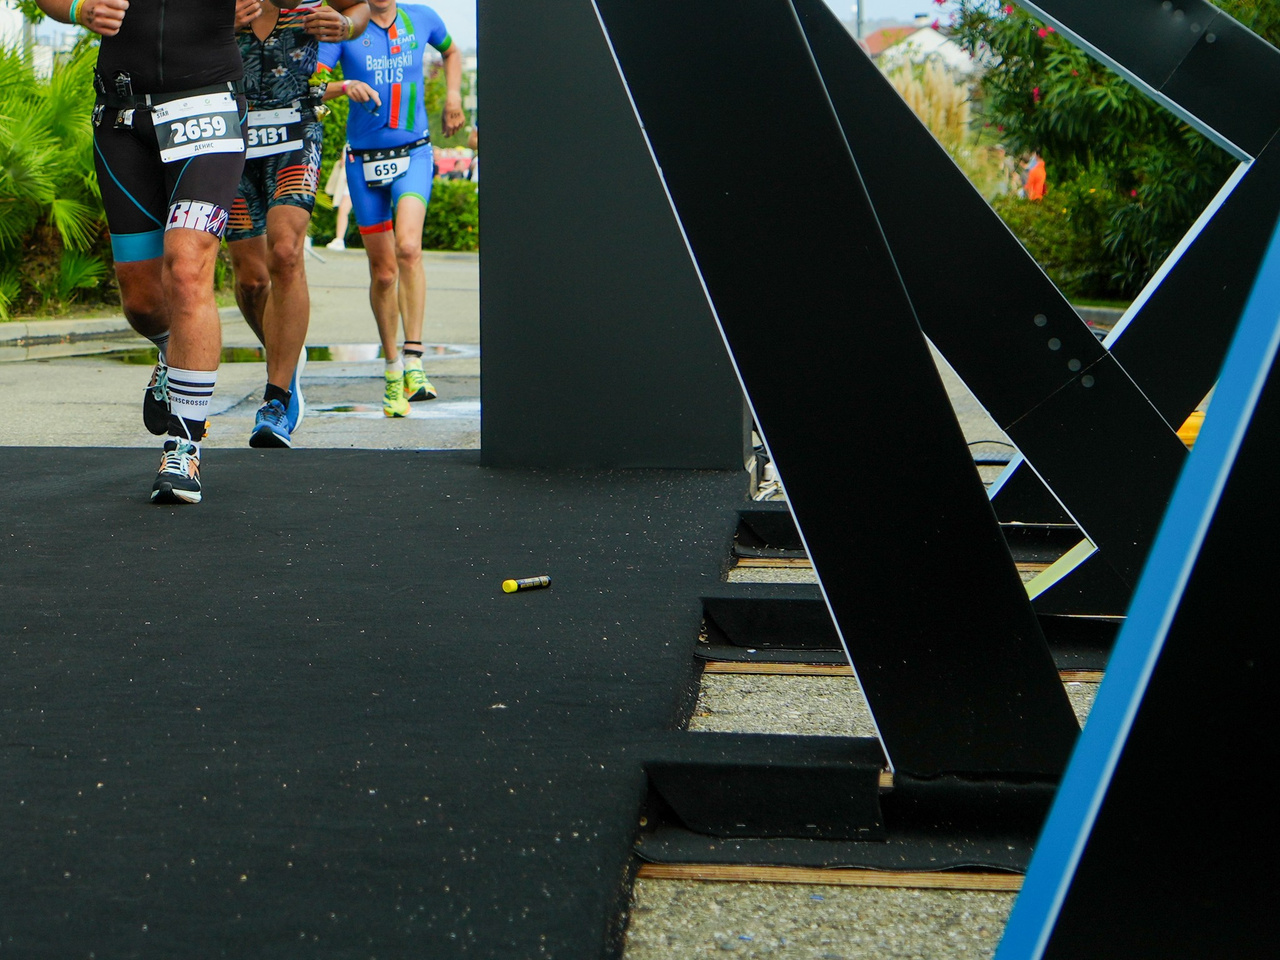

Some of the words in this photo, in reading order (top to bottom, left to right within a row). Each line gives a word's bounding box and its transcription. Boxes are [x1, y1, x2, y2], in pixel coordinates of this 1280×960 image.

[374, 68, 405, 85] RUS
[170, 115, 227, 144] 2659
[247, 126, 289, 147] 3131
[194, 142, 215, 152] ДЕНИС
[374, 162, 398, 177] 659
